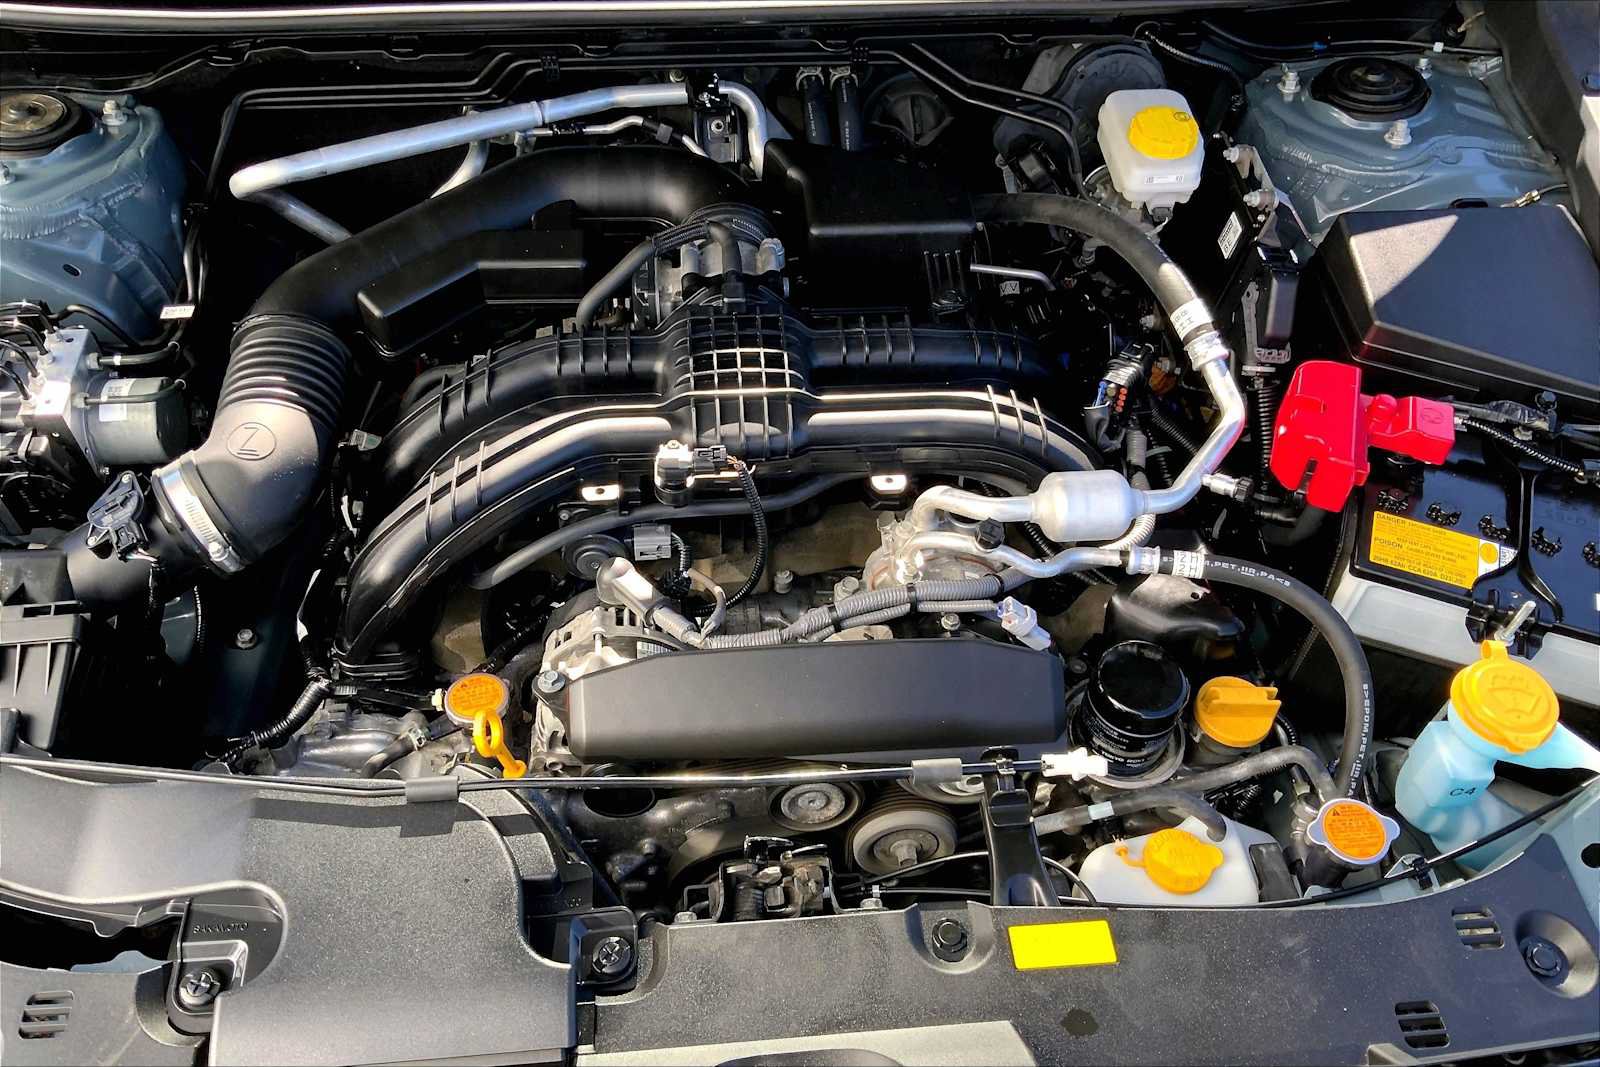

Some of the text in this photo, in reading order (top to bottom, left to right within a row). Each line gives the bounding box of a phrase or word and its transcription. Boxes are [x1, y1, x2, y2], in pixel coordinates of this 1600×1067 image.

[1376, 513, 1406, 528] DANGER
[1374, 537, 1403, 549] POISON
[1449, 787, 1476, 797] C4
